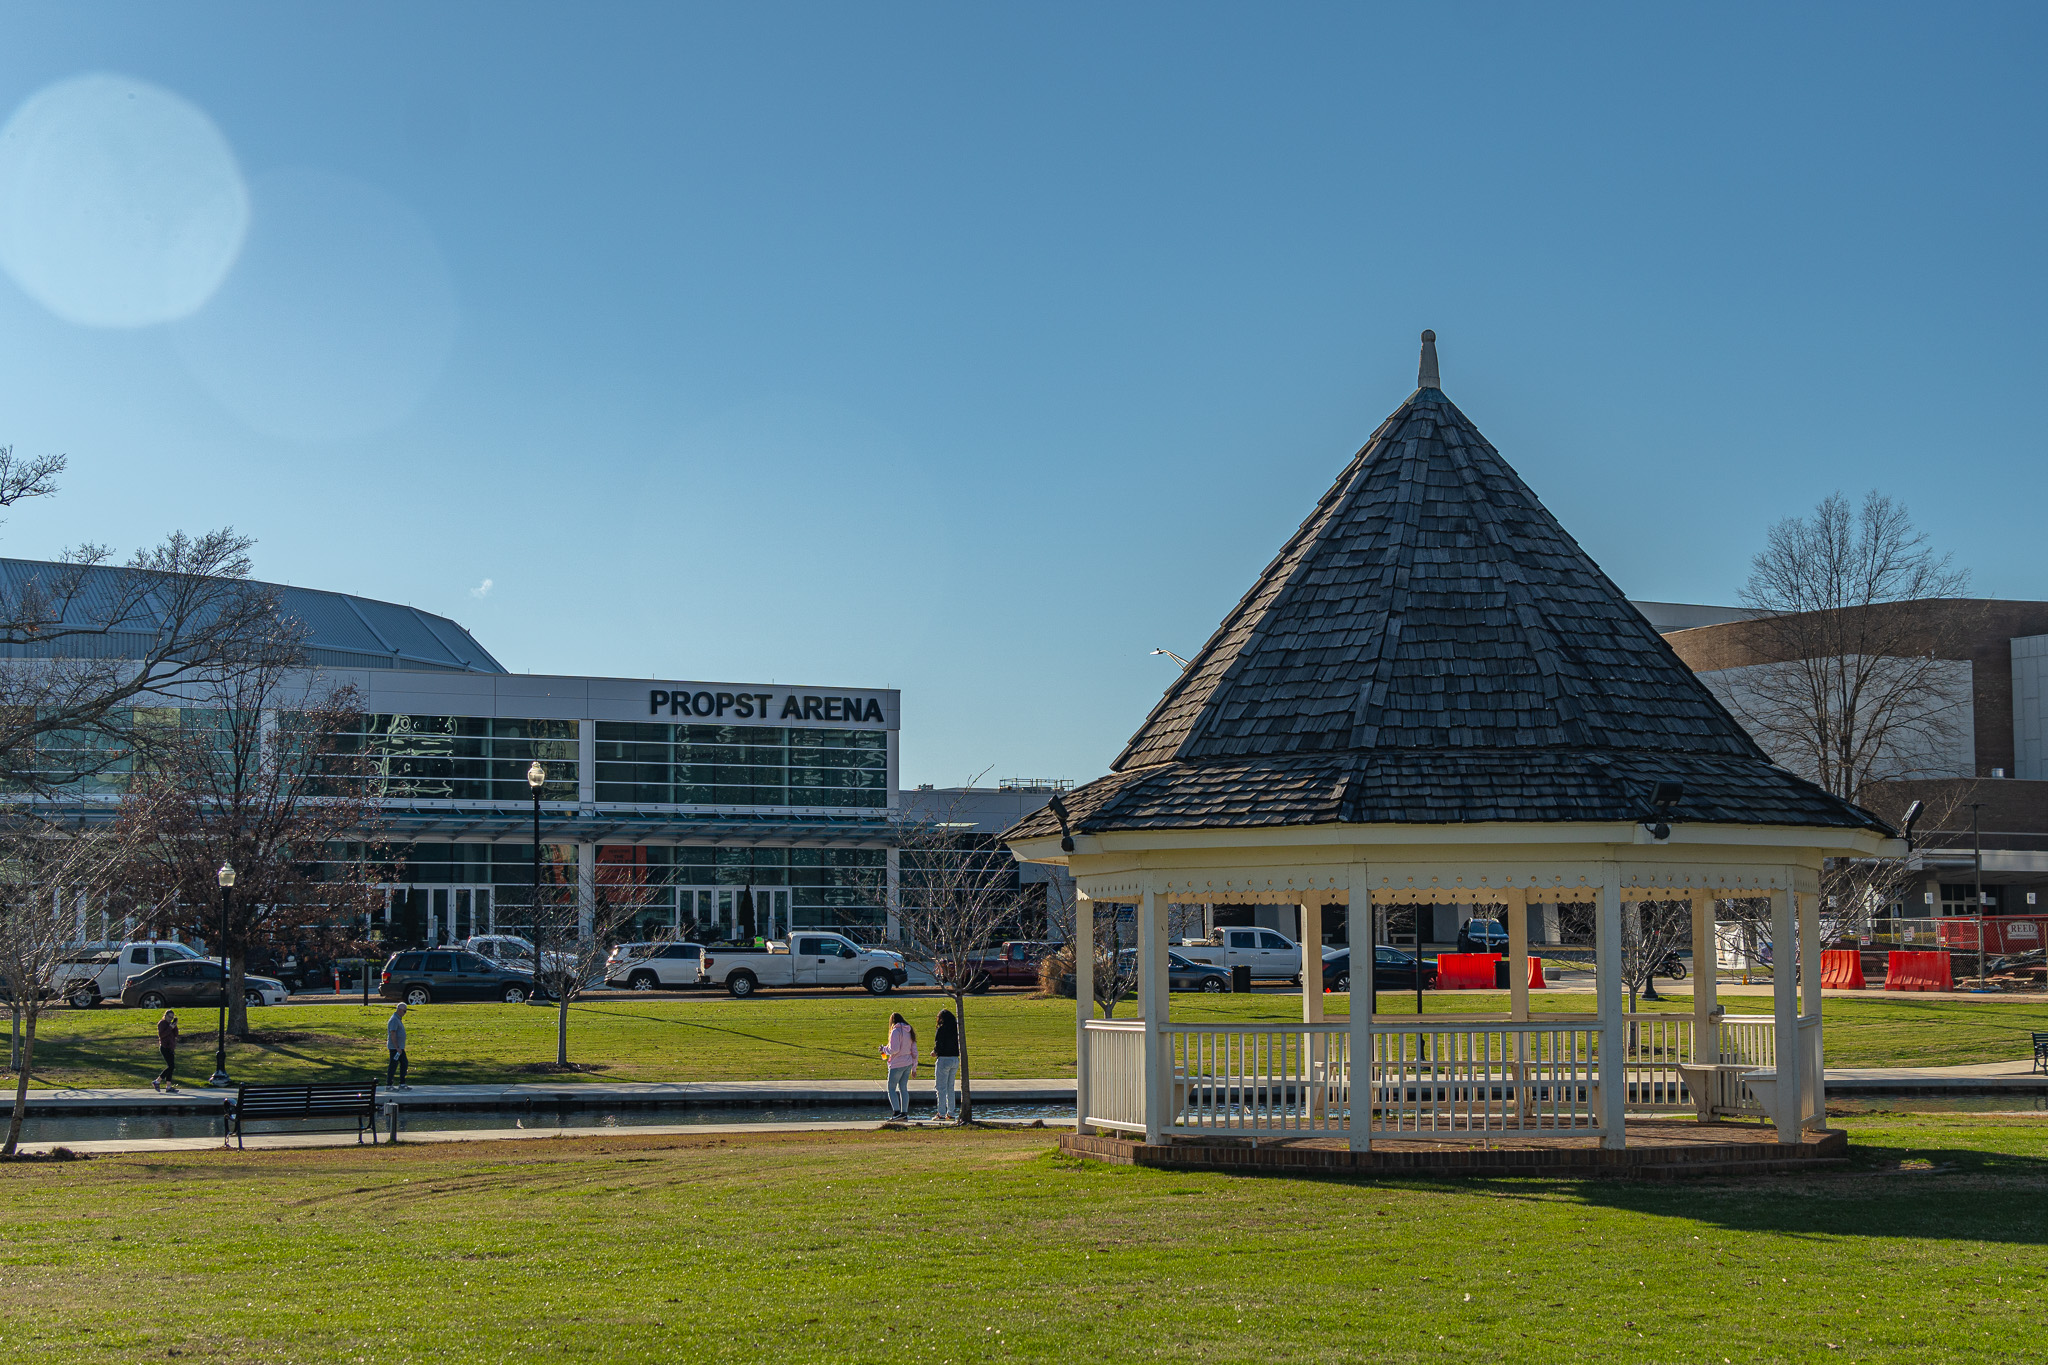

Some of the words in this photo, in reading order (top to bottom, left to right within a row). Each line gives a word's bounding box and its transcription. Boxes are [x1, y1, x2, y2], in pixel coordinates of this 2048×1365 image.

[650, 690, 773, 718] PROPST
[781, 695, 884, 722] ARENA
[2011, 924, 2035, 933] REED
